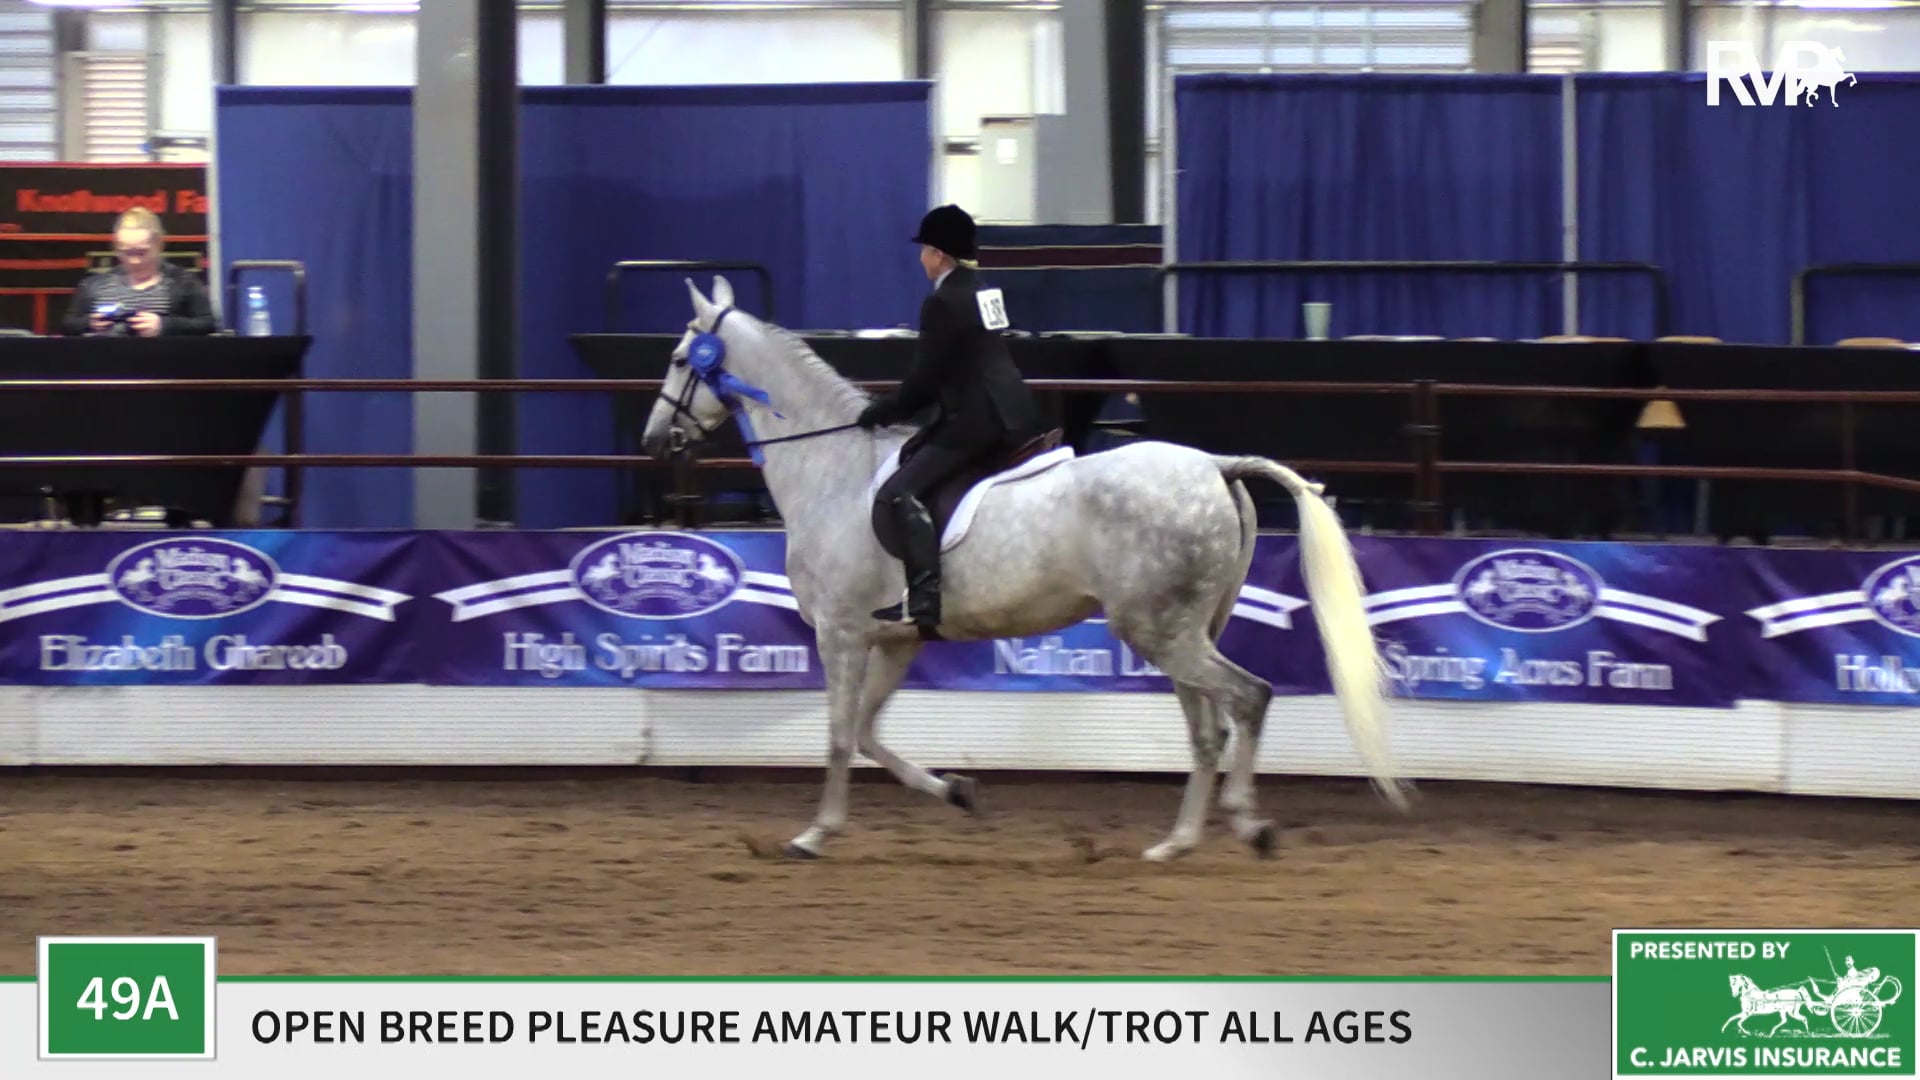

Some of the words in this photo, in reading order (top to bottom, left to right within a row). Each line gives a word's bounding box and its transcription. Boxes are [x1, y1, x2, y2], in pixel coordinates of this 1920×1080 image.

[39, 634, 196, 671] Elizabeth
[503, 632, 586, 678] High
[595, 633, 708, 678] Spirits
[715, 633, 810, 672] Farm
[993, 635, 1114, 676] Nathan
[1387, 644, 1487, 691] Spring
[1494, 647, 1584, 687] Acres
[1586, 650, 1674, 690] Farm
